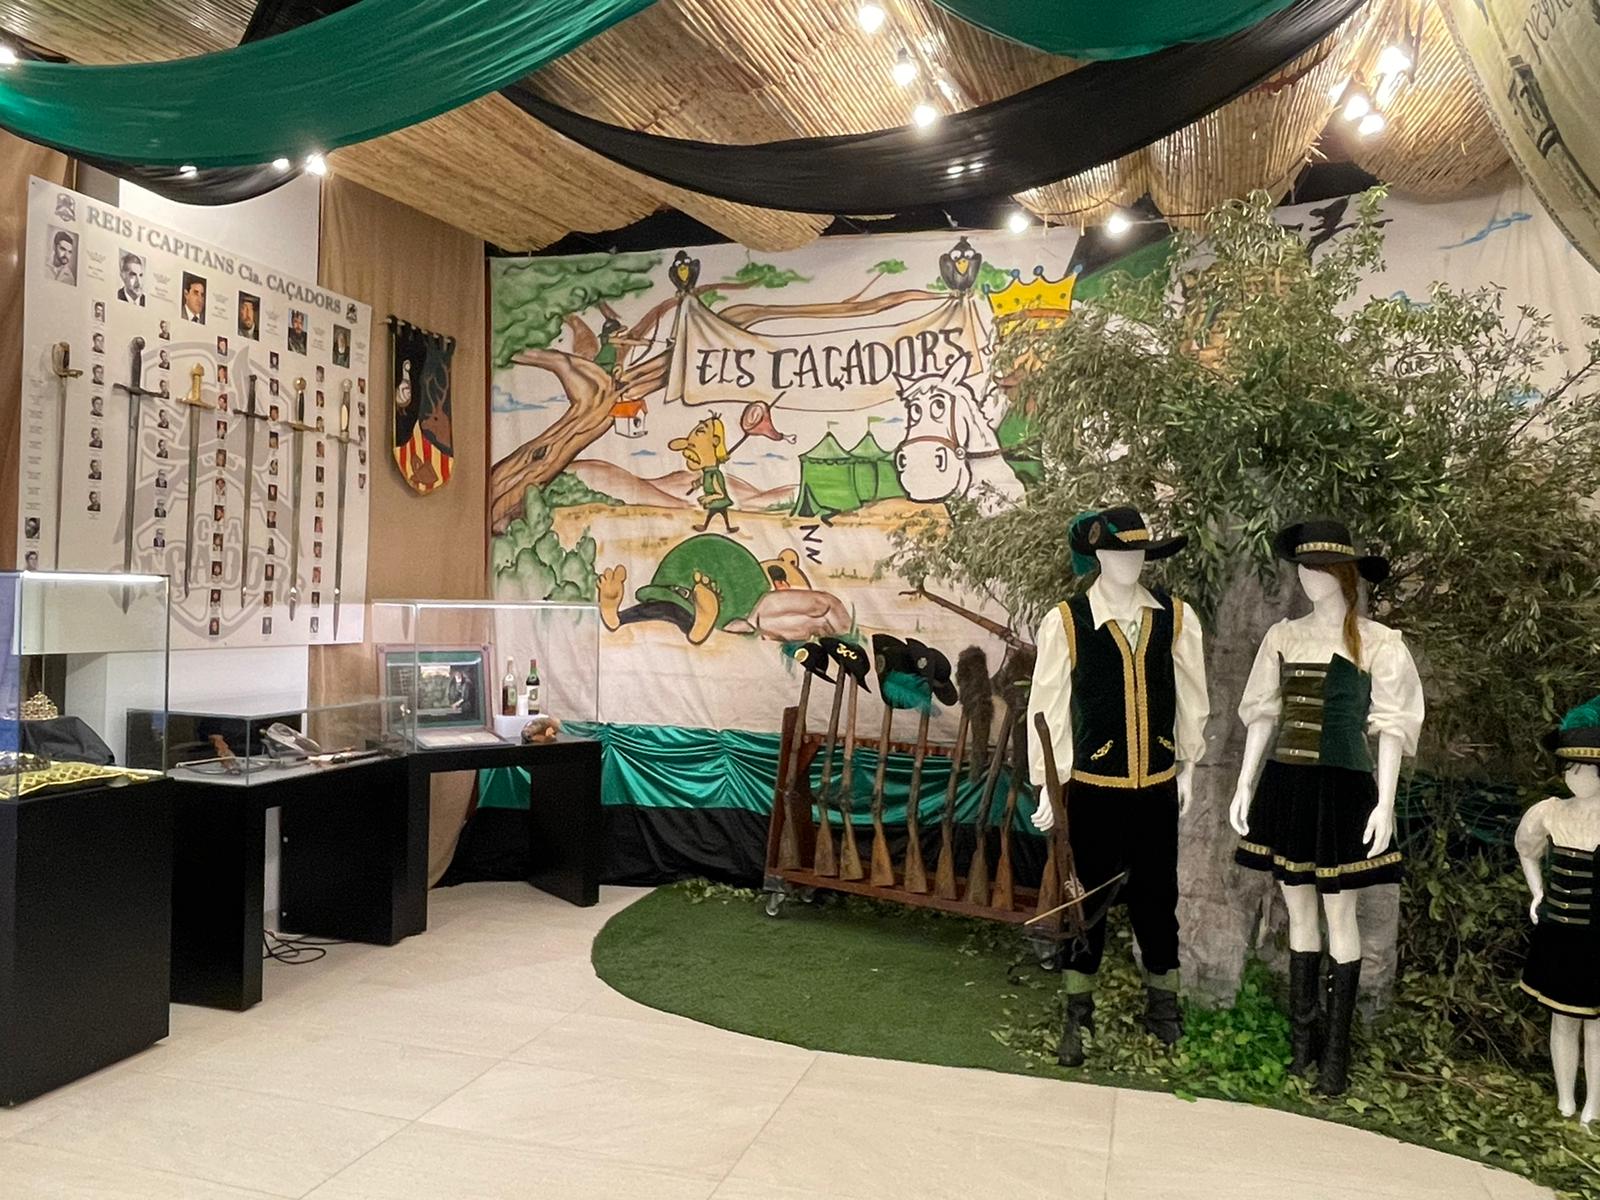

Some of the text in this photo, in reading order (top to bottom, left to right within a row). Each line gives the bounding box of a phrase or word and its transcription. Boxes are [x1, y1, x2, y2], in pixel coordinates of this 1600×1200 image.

[86, 205, 132, 238] REIS
[147, 229, 234, 276] CAPITANS
[266, 274, 342, 314] CAÇADORS
[697, 327, 967, 391] ELS CAÇADORS
